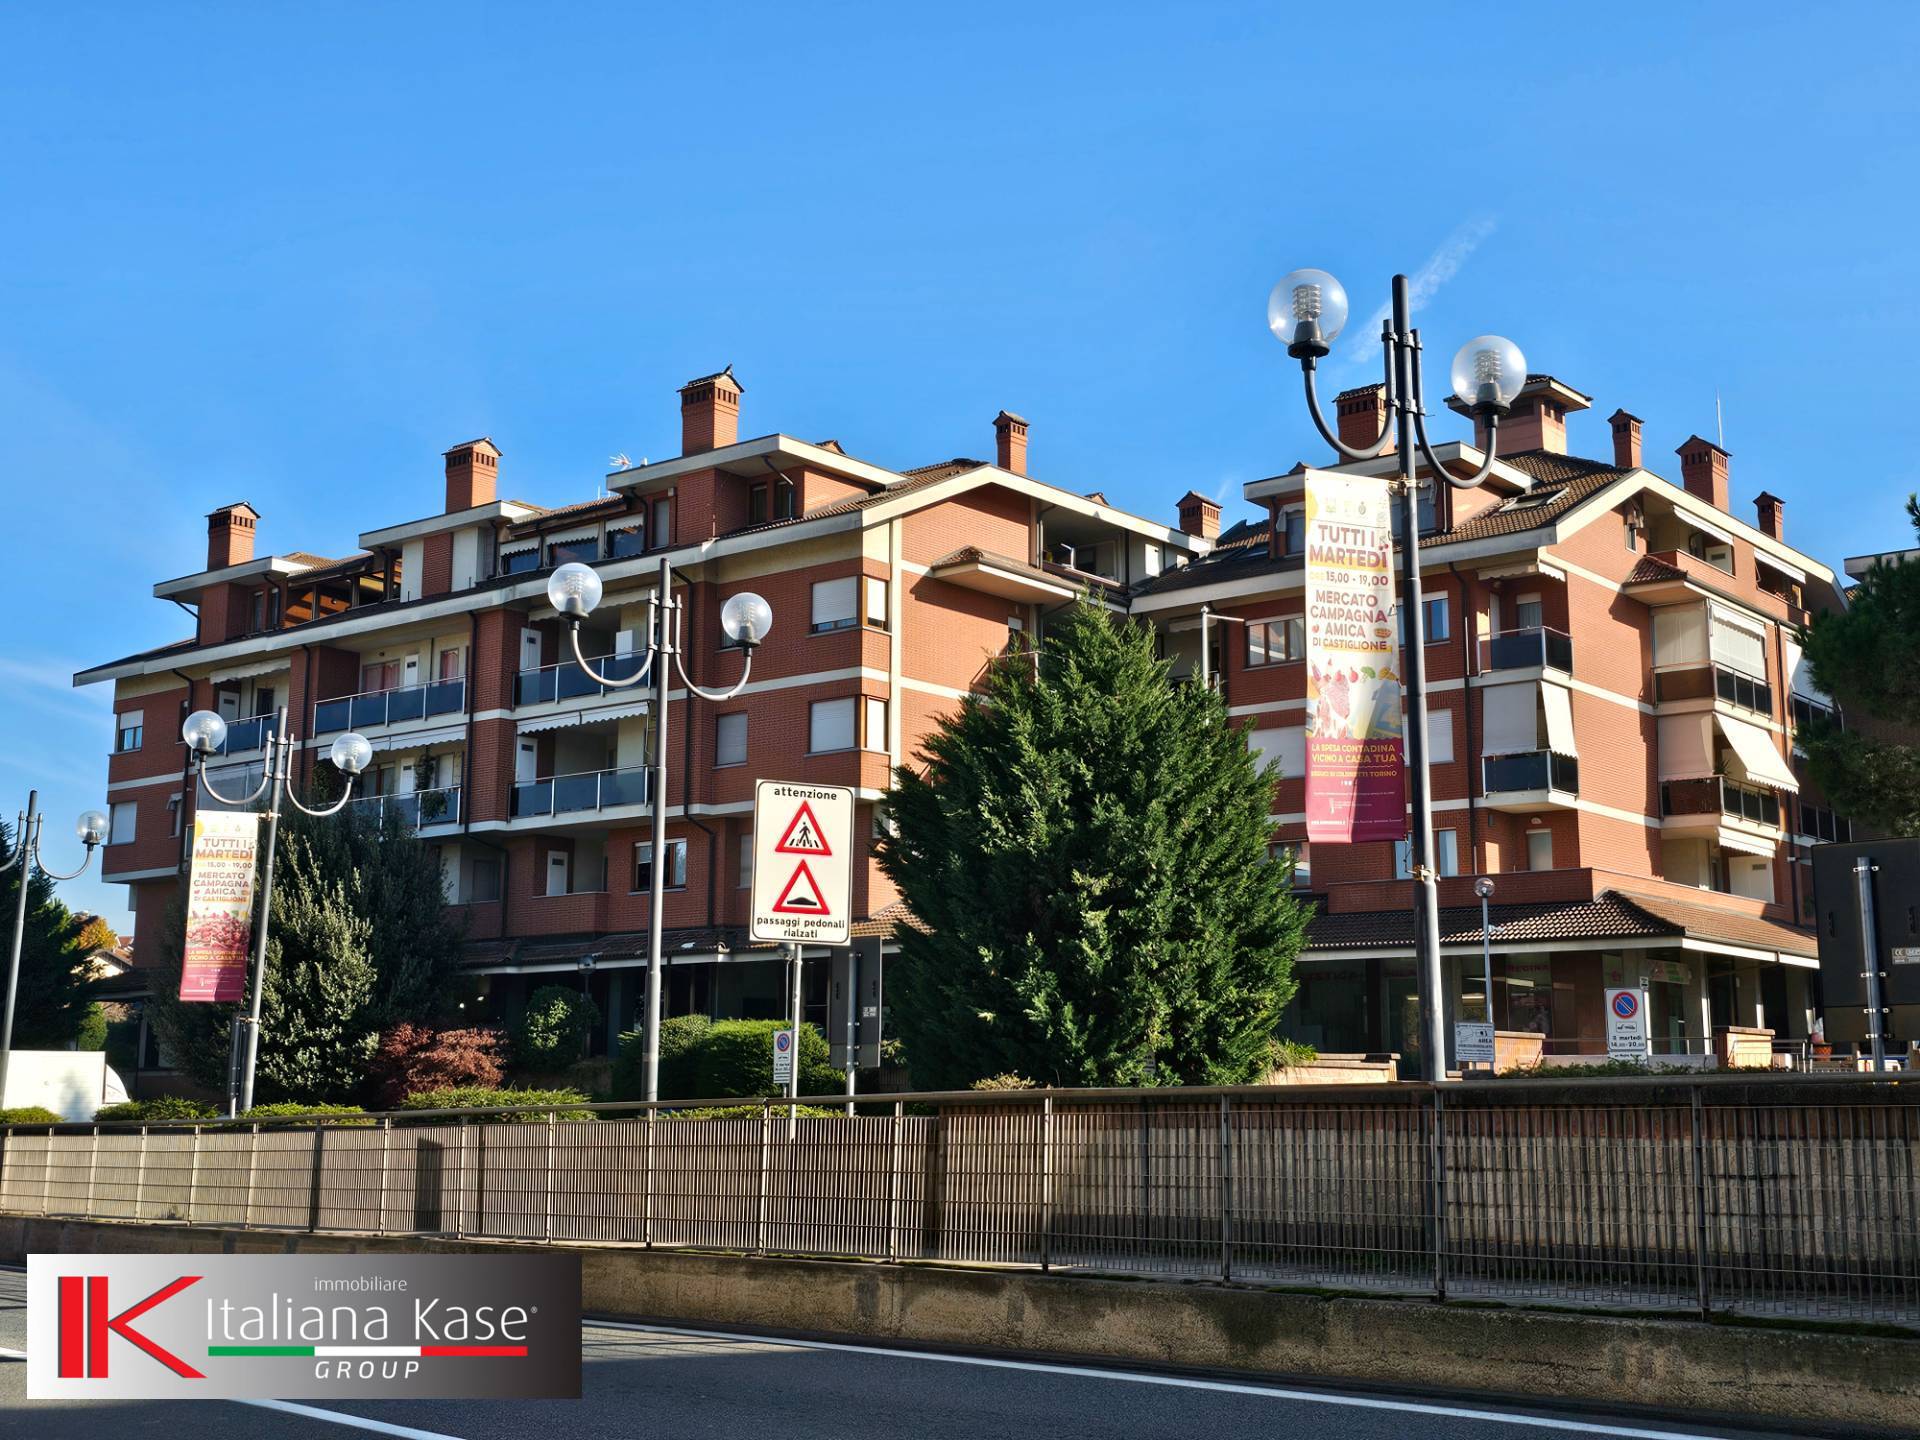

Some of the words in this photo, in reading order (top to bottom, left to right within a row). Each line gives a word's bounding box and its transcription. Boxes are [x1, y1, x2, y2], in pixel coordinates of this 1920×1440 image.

[1318, 525, 1365, 546] TUTTI
[1370, 531, 1375, 547] I
[1315, 590, 1378, 607] MERCATO
[1310, 605, 1388, 623] CAMPAGNA
[1324, 623, 1366, 638] AMICA
[1312, 637, 1321, 647] DI
[1323, 638, 1388, 650] CASTIGLIONE
[1341, 744, 1396, 753] CONTADINA
[1311, 753, 1337, 763] VICINO
[1345, 754, 1372, 763] CASA
[1374, 753, 1397, 763] TUA
[774, 786, 837, 800] attenzione
[203, 838, 239, 848] TUTTI
[198, 871, 246, 880] MERCATO
[193, 880, 249, 888] CAMPAGNA
[204, 888, 236, 896] AMICA
[757, 916, 800, 928] passaggi
[804, 918, 845, 929] pedonali
[783, 929, 818, 938] rialzati
